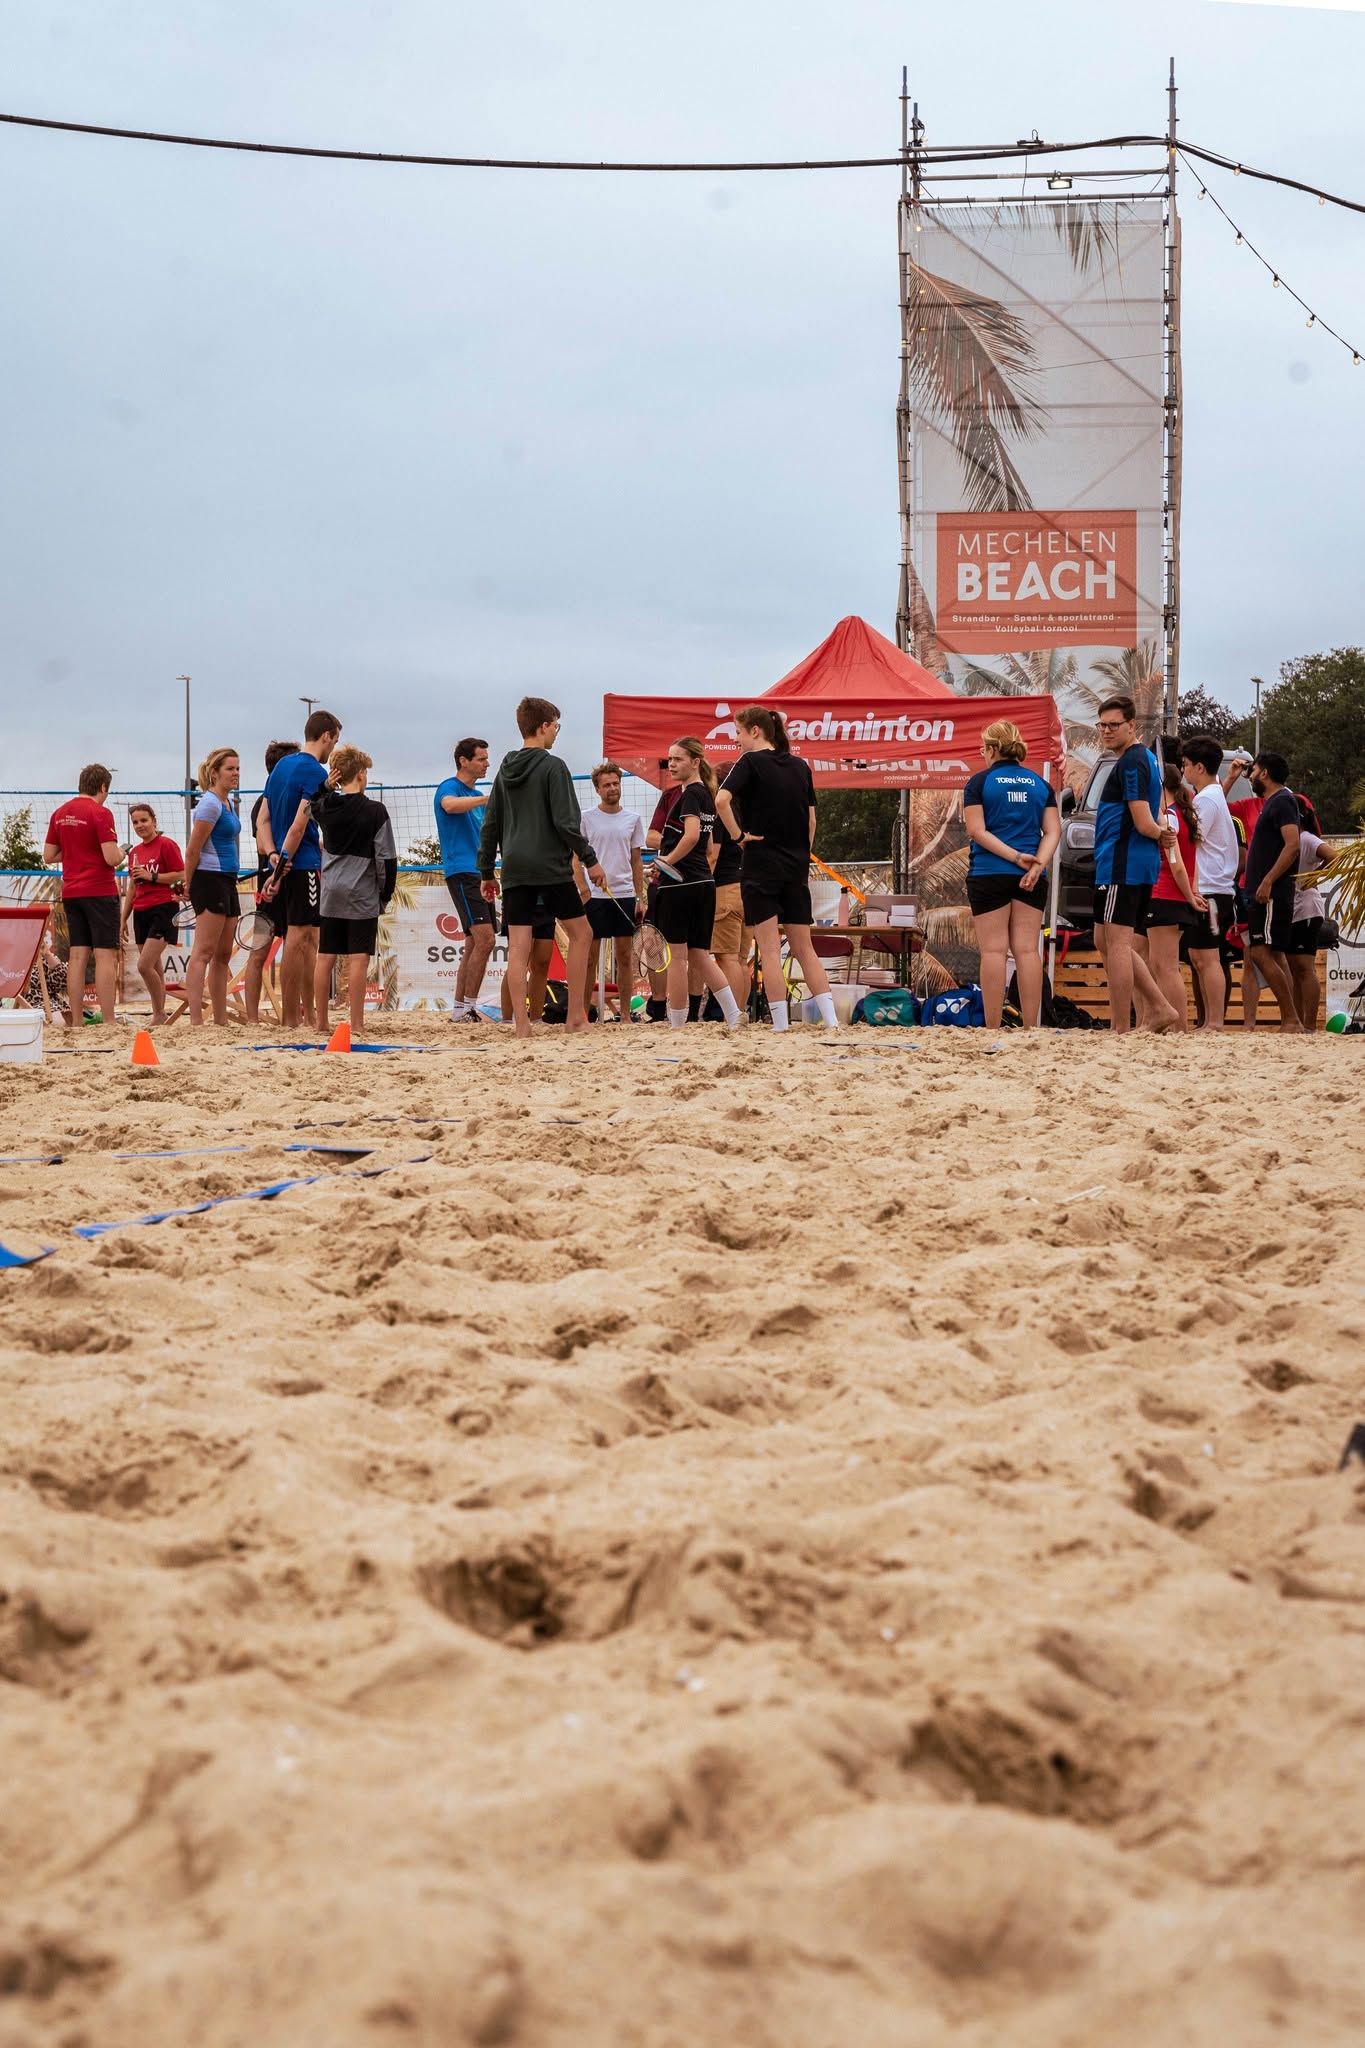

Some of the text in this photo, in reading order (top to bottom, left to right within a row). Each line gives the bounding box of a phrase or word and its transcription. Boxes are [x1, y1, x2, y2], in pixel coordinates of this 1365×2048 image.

[957, 531, 1117, 556] MECHELEN
[957, 560, 1117, 601] BEACH
[952, 614, 1000, 623] Strandbar
[1057, 613, 1115, 624] sportstrand
[994, 624, 1079, 634] Volleybal tornooi
[783, 711, 955, 742] adminton
[704, 743, 737, 751] POWERED
[1007, 791, 1028, 803] TINNE
[1329, 969, 1365, 981] Ottev
